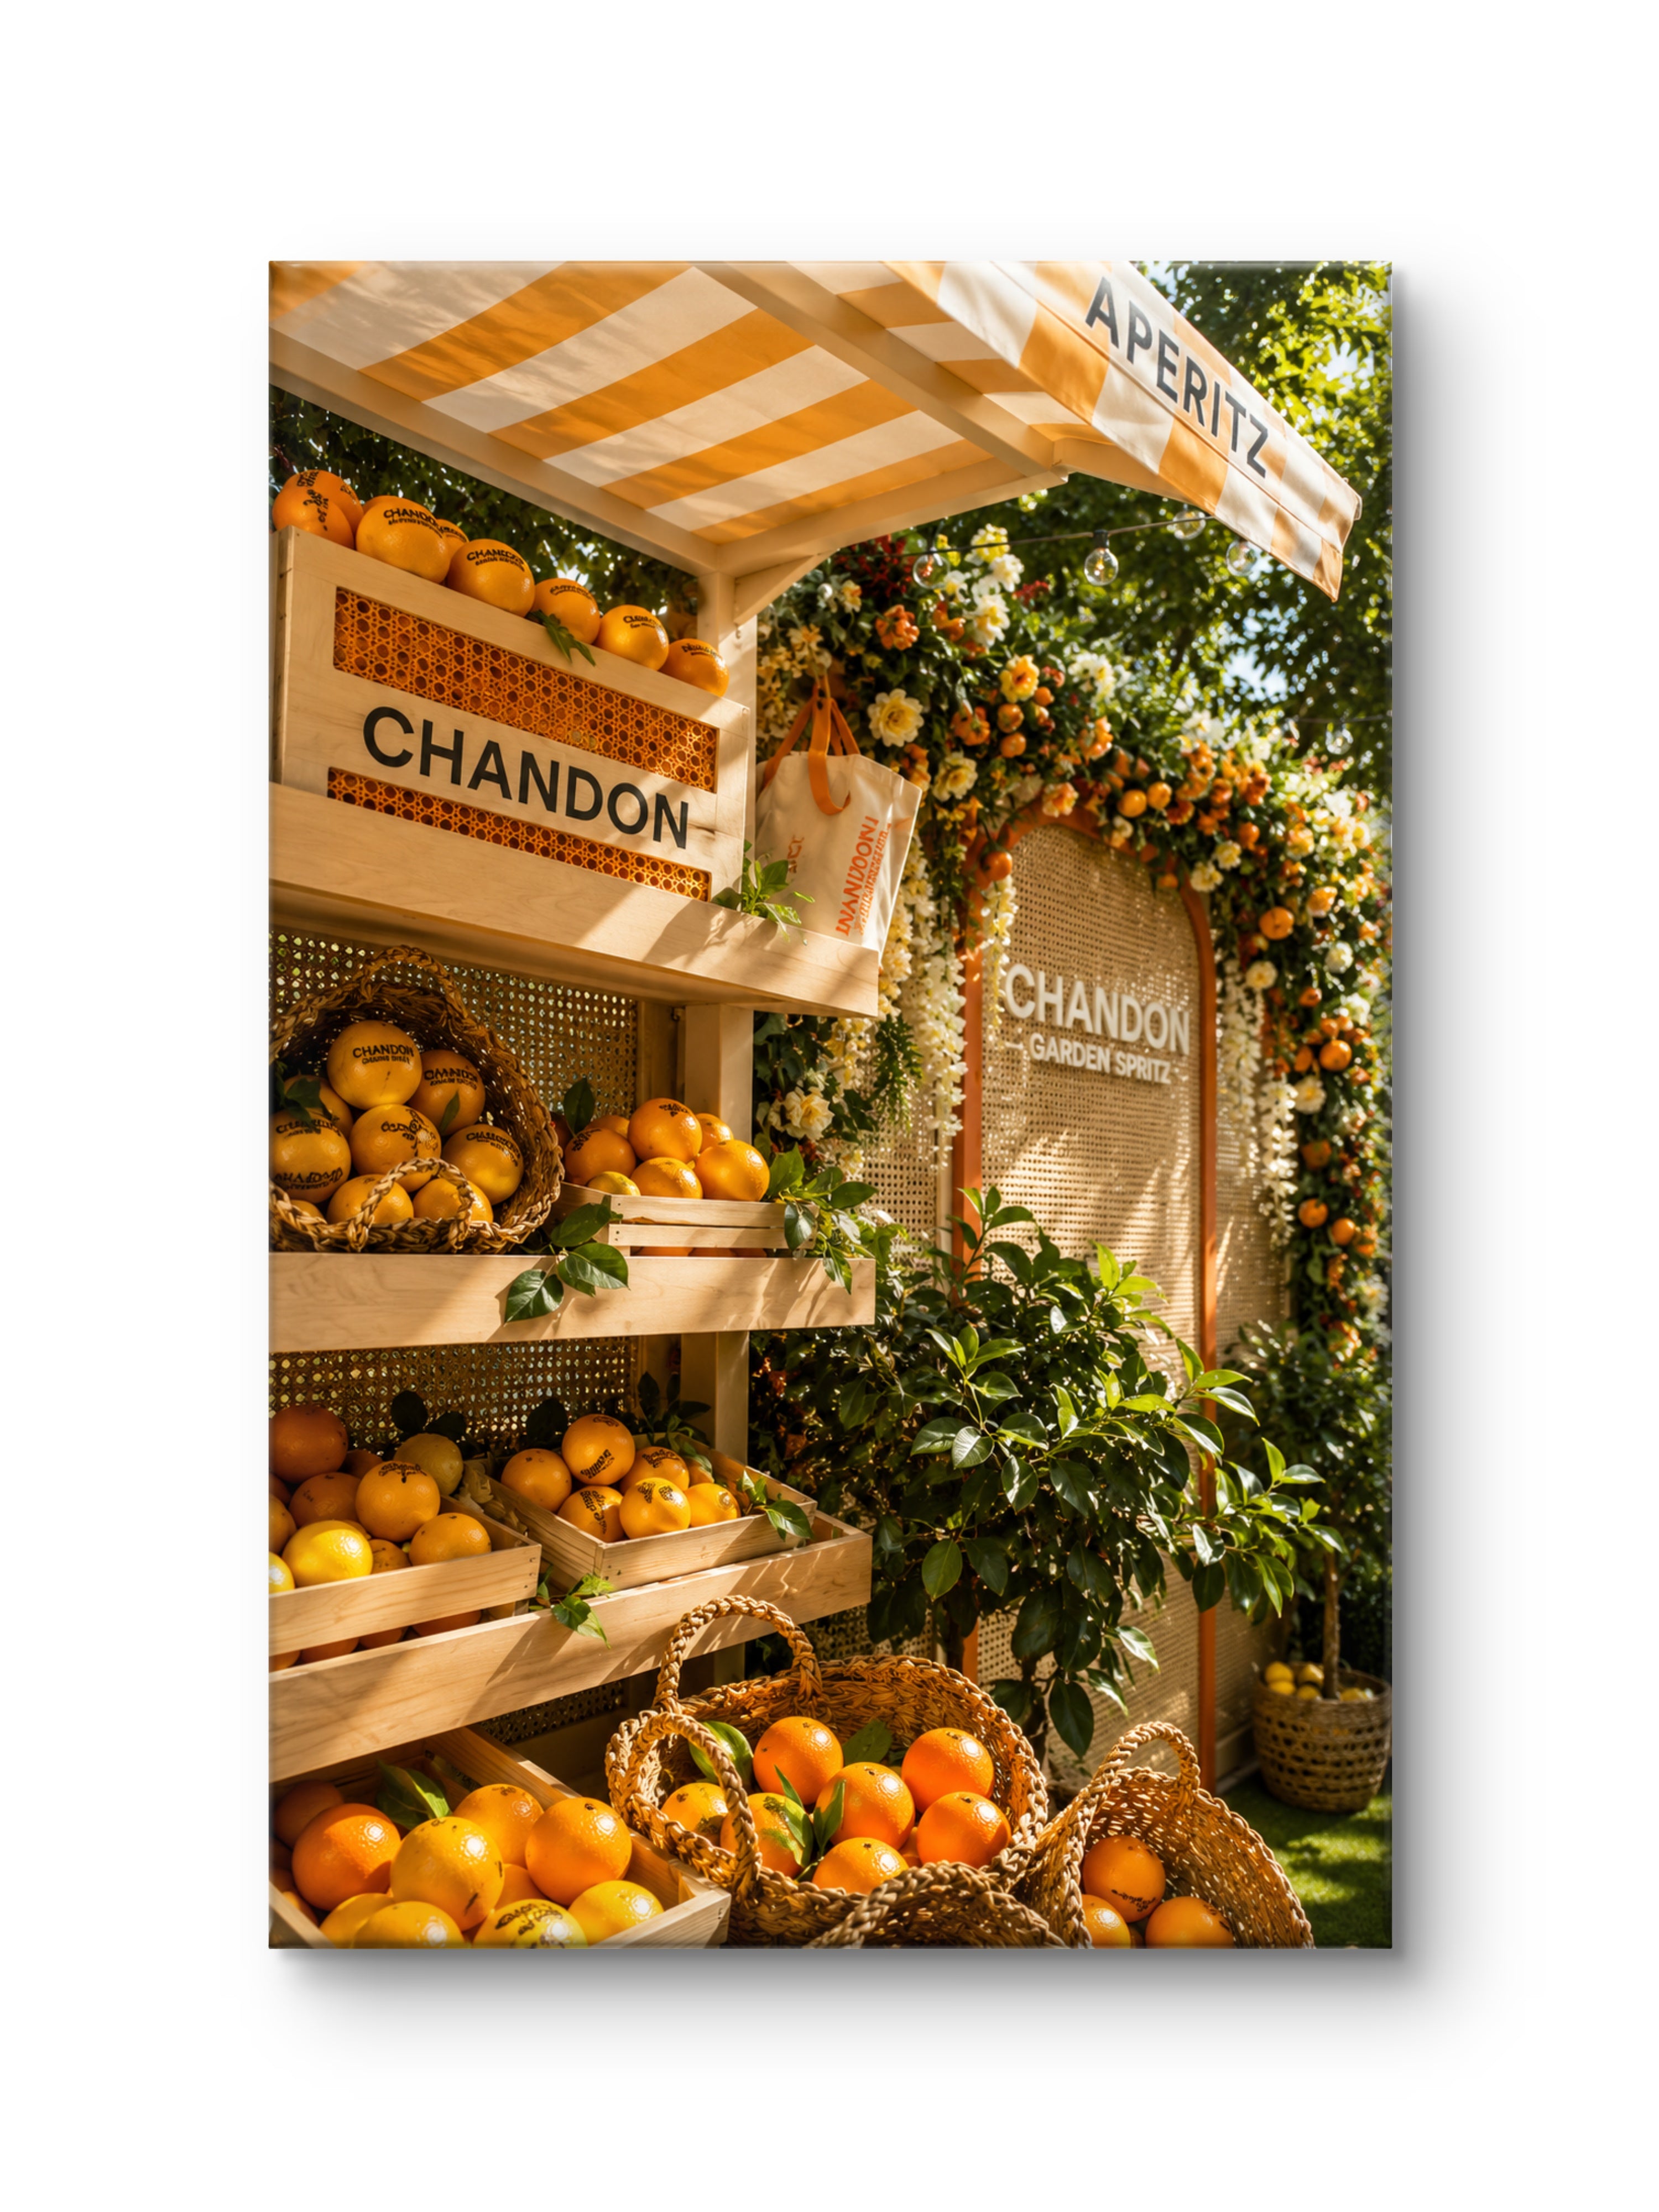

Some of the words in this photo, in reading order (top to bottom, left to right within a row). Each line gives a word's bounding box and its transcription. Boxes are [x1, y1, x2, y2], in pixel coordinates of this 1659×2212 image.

[1085, 276, 1269, 479] APERITZ
[363, 706, 689, 849] CHANDON
[1005, 963, 1190, 1055] CHANDON
[1029, 1032, 1111, 1074] GARDEN
[1115, 1050, 1172, 1084] SPRITZ
